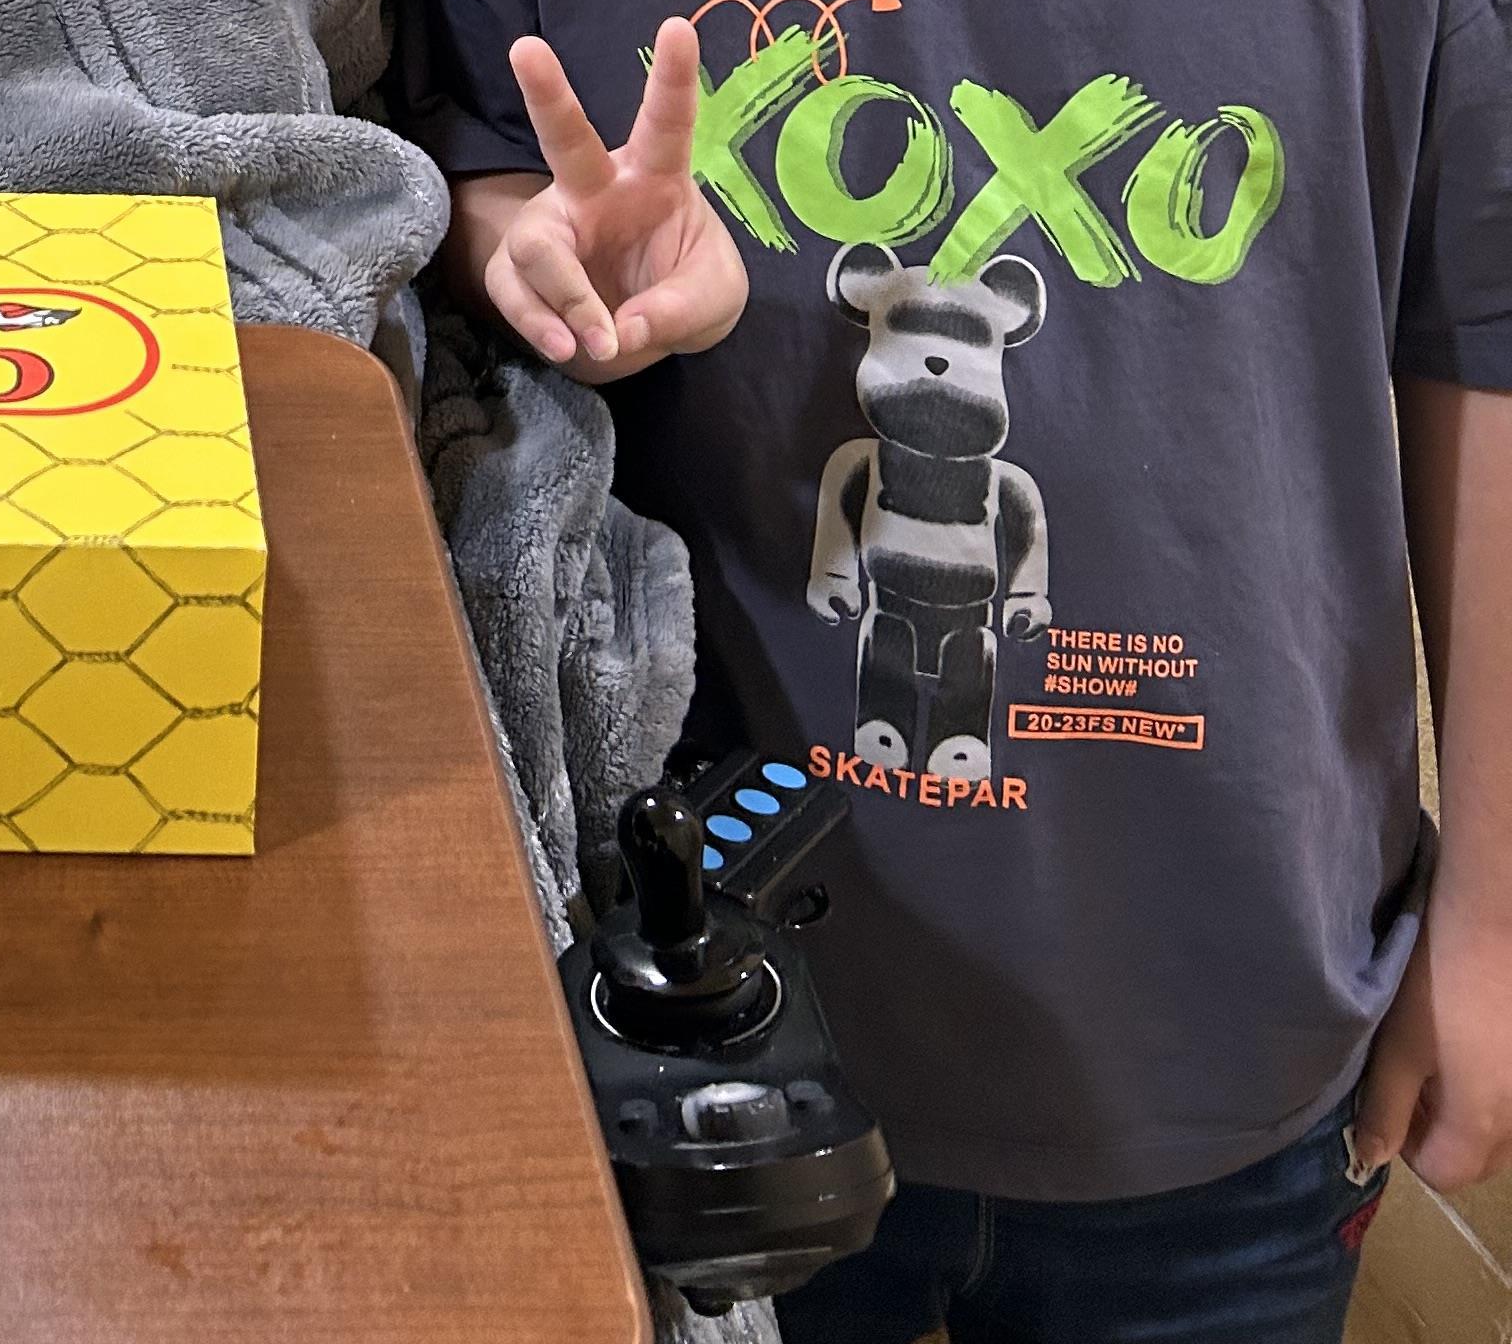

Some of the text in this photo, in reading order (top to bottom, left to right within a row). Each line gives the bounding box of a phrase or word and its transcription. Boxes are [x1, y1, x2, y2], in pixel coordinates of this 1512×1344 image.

[1047, 628, 1184, 655] THERE IS NO
[1046, 652, 1198, 679] SUN WITHOUT
[1044, 673, 1138, 697] #SHOW#
[1027, 713, 1116, 733] 20-23FS
[807, 744, 1028, 811] SKATEPAR
